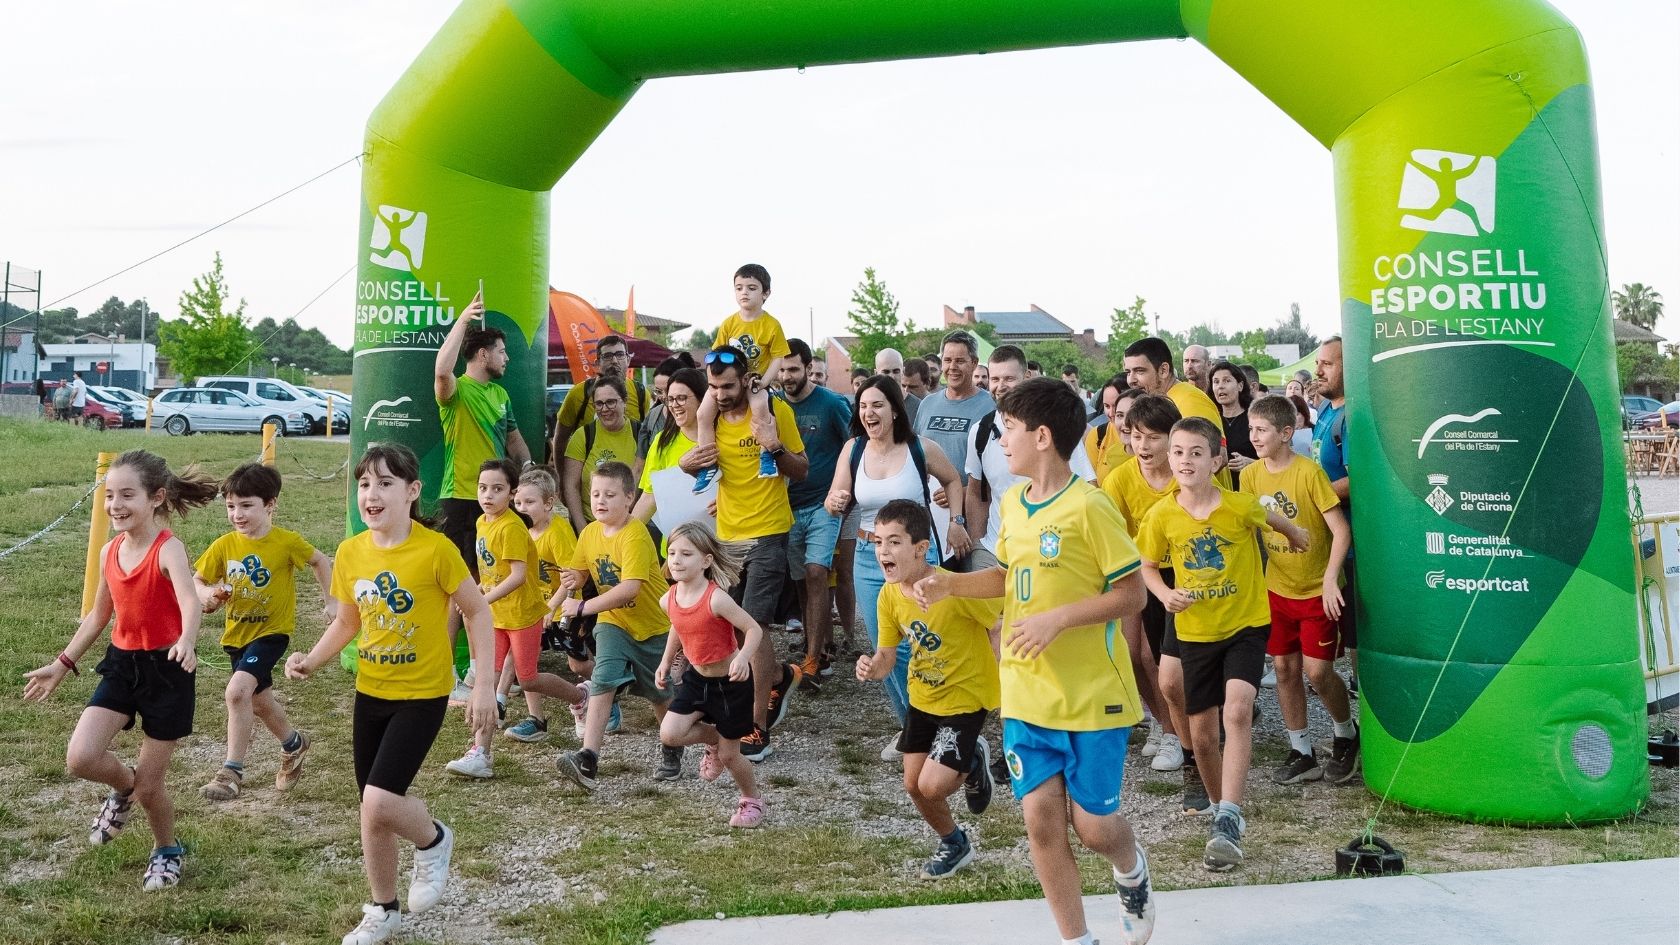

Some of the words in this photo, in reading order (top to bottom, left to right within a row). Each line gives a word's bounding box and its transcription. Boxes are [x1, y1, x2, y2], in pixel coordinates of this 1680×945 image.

[1373, 249, 1539, 282] CONSELL
[358, 281, 450, 302] CONSELL
[1370, 282, 1546, 315] ESPORTIU
[356, 305, 455, 326] ESPORTIU
[1375, 320, 1408, 339] PLA
[1411, 319, 1438, 337] DE
[1445, 318, 1544, 336] L'ESTANY
[369, 331, 382, 343] DE
[1444, 430, 1467, 439] Consell
[1467, 430, 1499, 439] Comarcal
[1445, 442, 1455, 450] del
[1455, 442, 1466, 450] Pla
[1466, 442, 1475, 450] de
[1459, 491, 1511, 503] Diputació
[1286, 504, 1295, 517] 5
[1460, 501, 1474, 511] de
[1476, 501, 1513, 512] Girona
[1448, 534, 1511, 545] Generalitat
[1449, 545, 1463, 556] de
[1465, 546, 1523, 559] Catalunya
[247, 557, 256, 571] 3
[256, 570, 266, 585] 5
[380, 575, 391, 595] 3
[1015, 566, 1031, 602] 10
[1208, 584, 1238, 599] PUIG
[1445, 577, 1530, 594] esportcat
[393, 591, 408, 611] 5
[925, 635, 937, 649] 5
[358, 650, 377, 664] CAN
[380, 652, 417, 665] PUIG
